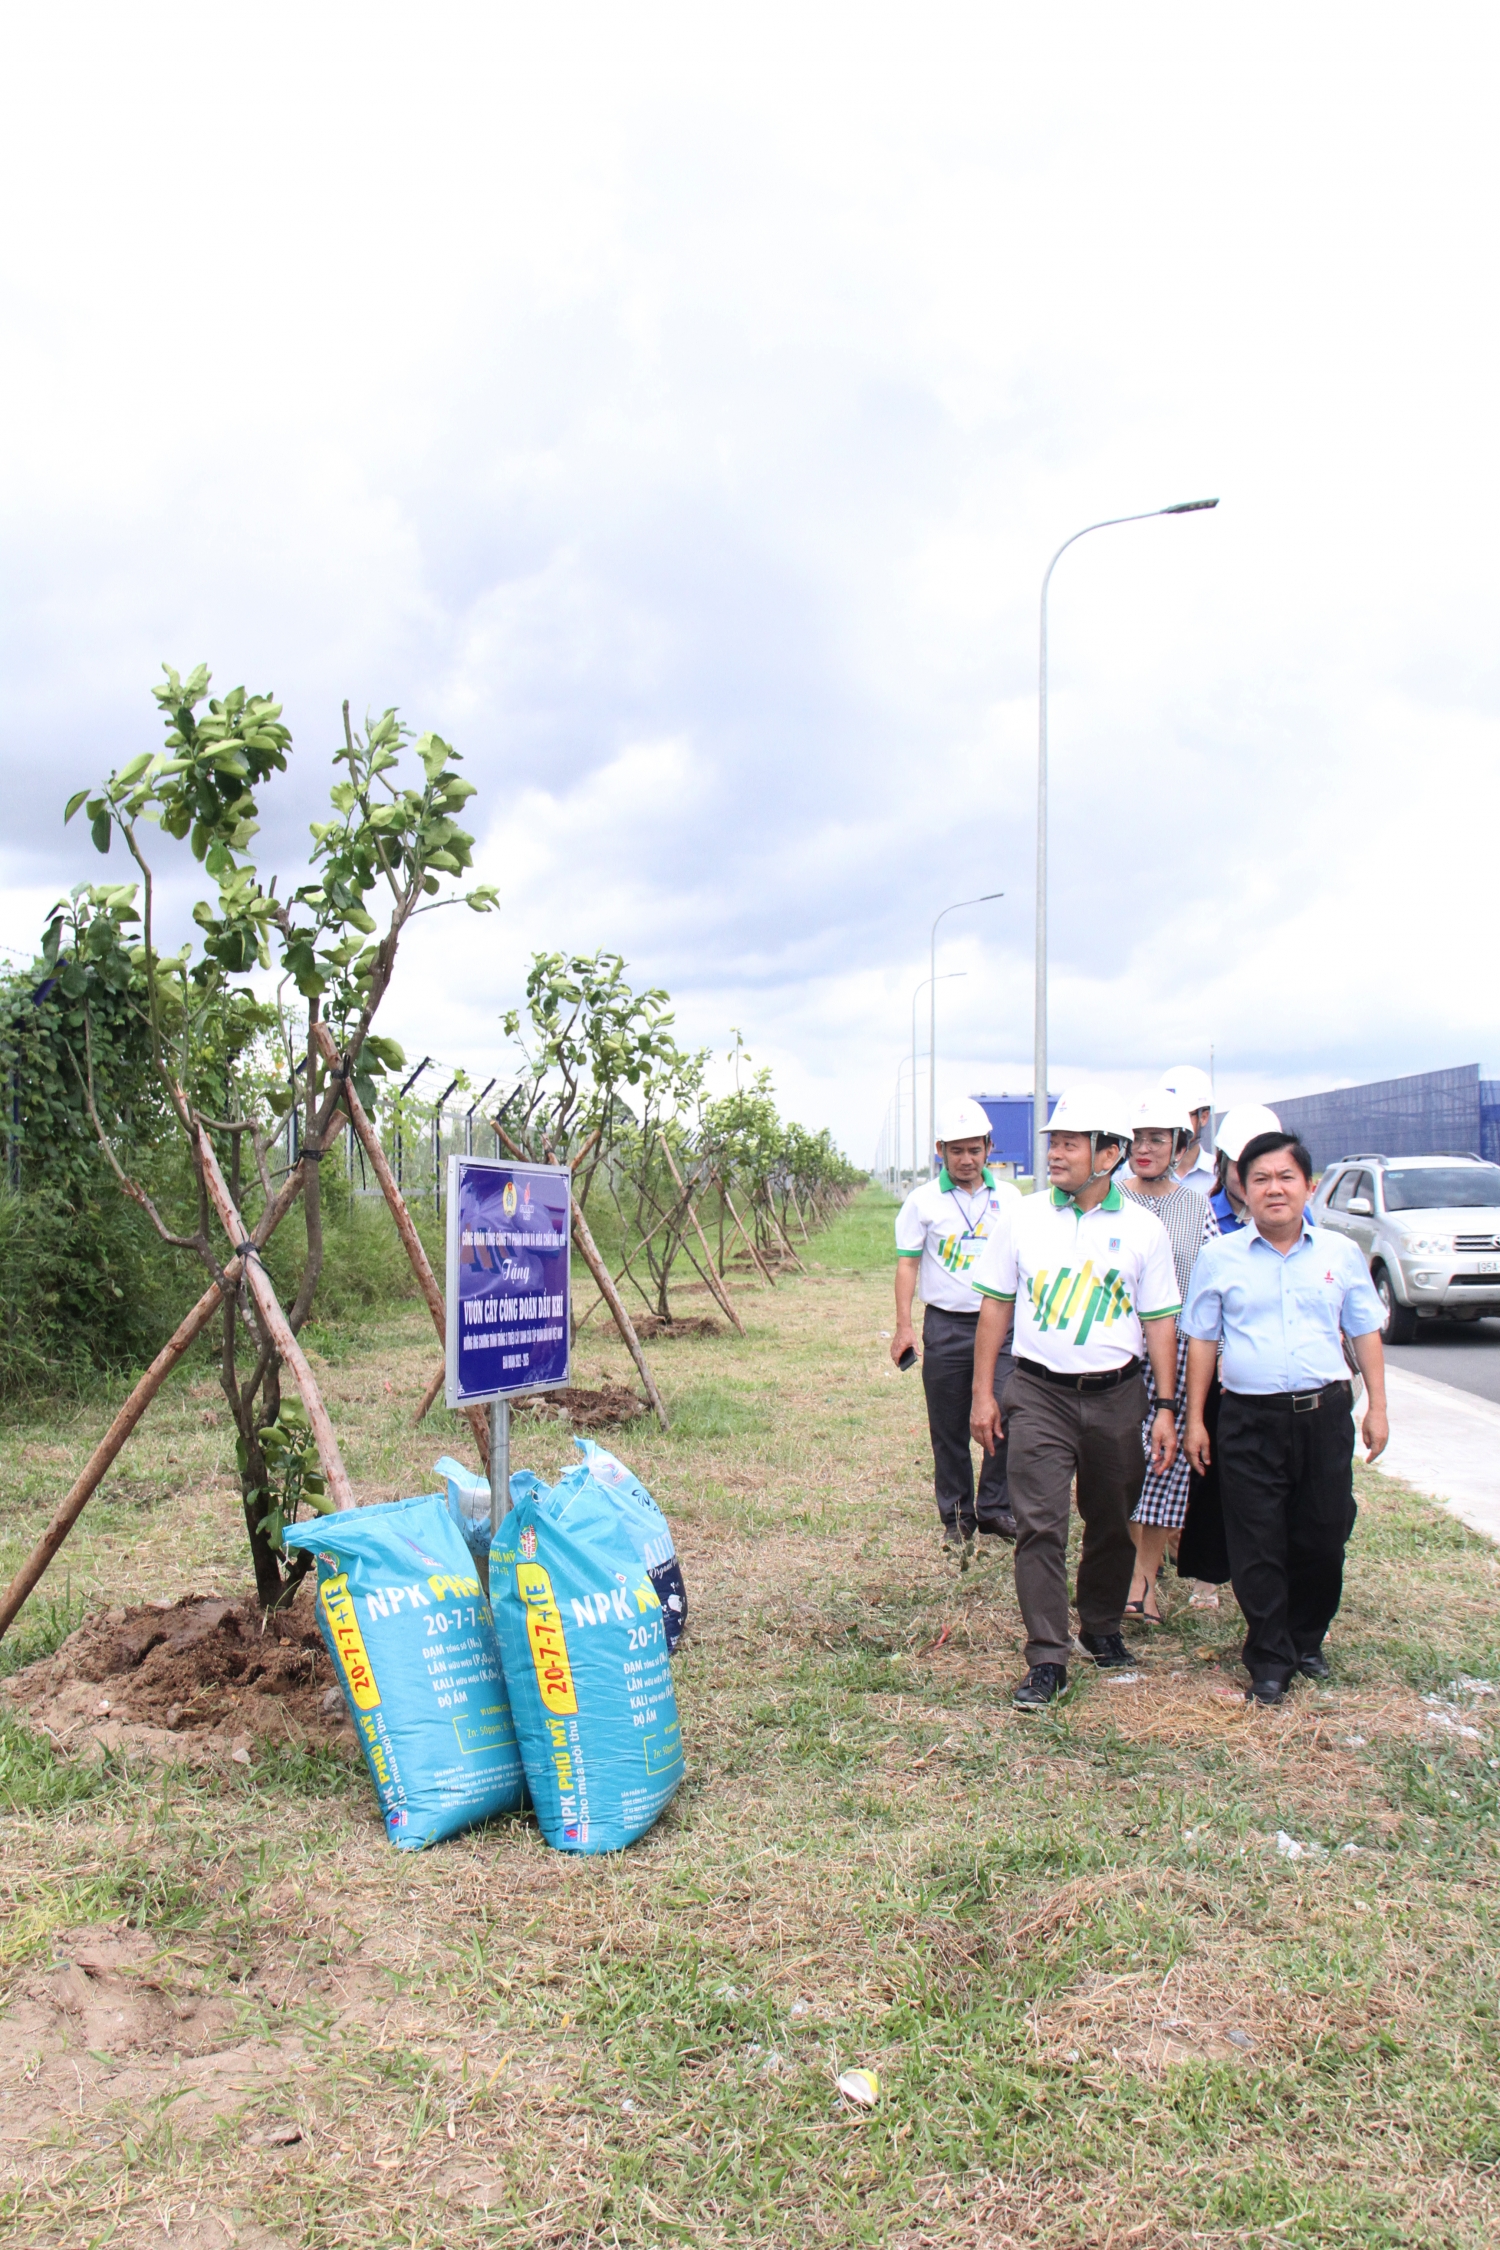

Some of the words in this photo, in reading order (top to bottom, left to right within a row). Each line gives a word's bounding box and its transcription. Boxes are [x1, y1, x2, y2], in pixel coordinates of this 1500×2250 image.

[502, 1258, 530, 1284] Tặng
[464, 1294, 484, 1325] VƯỜN
[484, 1294, 498, 1323] CÂY
[500, 1292, 518, 1322] CÔNG
[519, 1292, 538, 1320] ĐOÀN
[538, 1287, 551, 1318] DẦU
[552, 1290, 563, 1317] KHÍ
[365, 1584, 430, 1622] NPK
[570, 1586, 635, 1628] NPK
[422, 1644, 445, 1660] ĐẠM
[427, 1661, 447, 1675] LÂN
[624, 1659, 643, 1676] ĐẠM
[432, 1676, 455, 1692] KALI
[626, 1677, 643, 1692] LÂN
[438, 1692, 452, 1709] ĐỘ
[630, 1694, 648, 1709] KALI
[360, 1715, 378, 1743] MỸ
[375, 1712, 386, 1734] thu
[568, 1720, 580, 1742] thu
[633, 1711, 645, 1728] ĐỘ
[545, 1718, 568, 1748] MỸ
[370, 1744, 390, 1785] PHÚ
[388, 1756, 401, 1783] mùa
[551, 1752, 574, 1790] PHÚ
[576, 1767, 587, 1795] mùa
[580, 1798, 590, 1824] Cho
